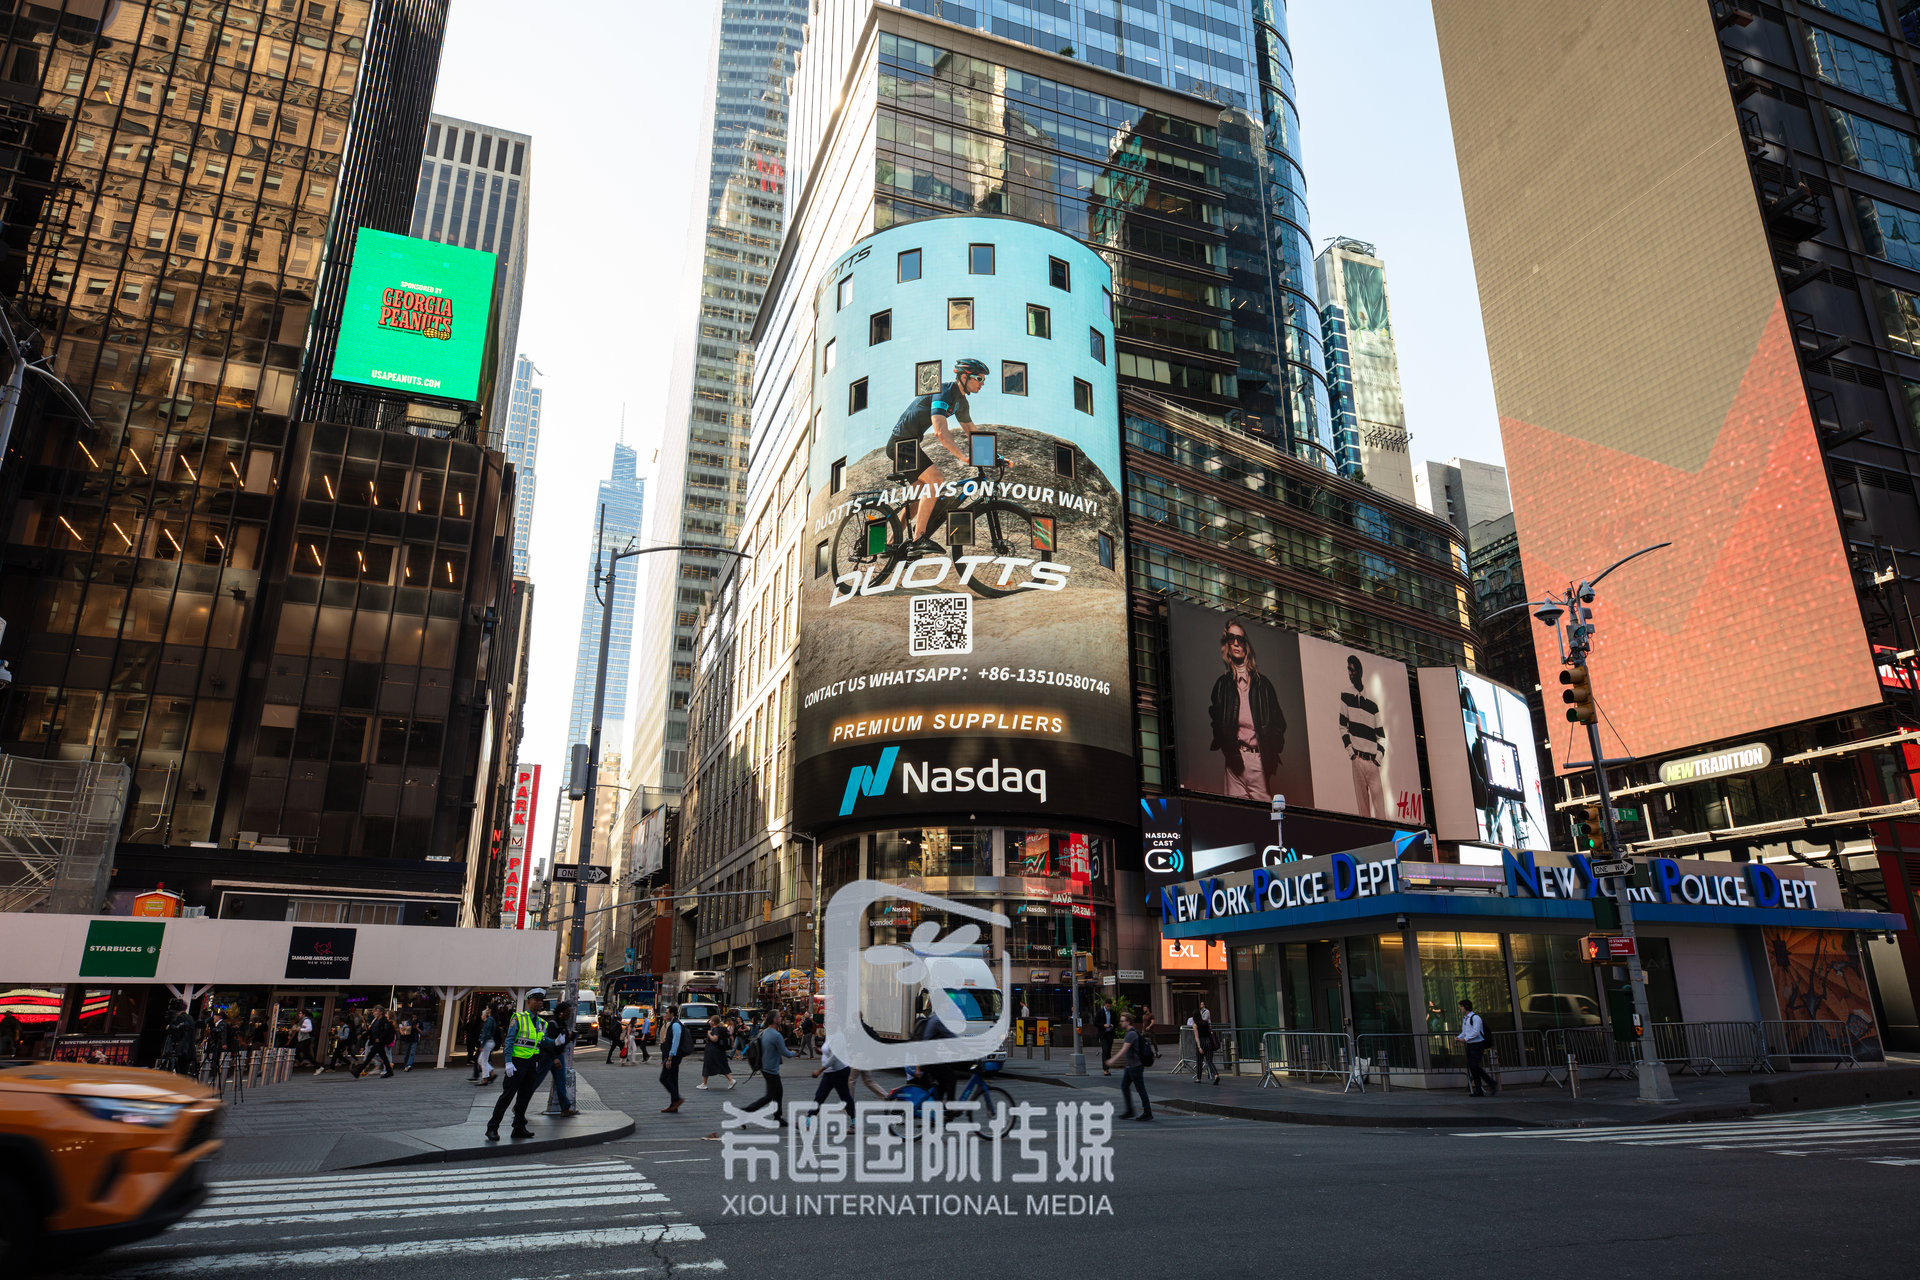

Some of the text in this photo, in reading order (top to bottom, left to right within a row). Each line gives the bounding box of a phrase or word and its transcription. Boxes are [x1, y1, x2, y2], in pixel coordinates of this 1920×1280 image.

[382, 287, 453, 318] GEORGIA
[400, 281, 442, 295] SPONSORED BY
[378, 305, 453, 334] PEANUTS
[371, 369, 441, 389] USAPEANUTS.COM
[814, 497, 863, 536] DUOTTS
[876, 481, 958, 507] ALWAYS
[962, 480, 995, 497] ON
[999, 482, 1055, 504] YOUR
[1058, 490, 1098, 517] WAY!
[829, 555, 1072, 608] DUOTTS
[804, 680, 847, 709] CONTACT
[847, 675, 867, 693] US
[978, 666, 1111, 696] +86-13510580746
[832, 713, 1063, 743] PREMIUM SUPPLIERS
[902, 758, 1047, 804] Nasdaq
[514, 772, 531, 825] PARK
[1396, 790, 1421, 822] H&M
[1502, 848, 1576, 898] NEW
[1655, 858, 1750, 907] POLICE
[1752, 864, 1817, 909] DEPT
[1595, 863, 1629, 874] ONE WAY
[503, 857, 521, 913] PARK
[1161, 853, 1397, 925] NEW YORK POLICE DEPT
[891, 905, 911, 914] Nasdaq
[1026, 906, 1047, 914] Nasdaq
[89, 945, 142, 953] STARBUCKS
[1169, 945, 1200, 958] EXL
